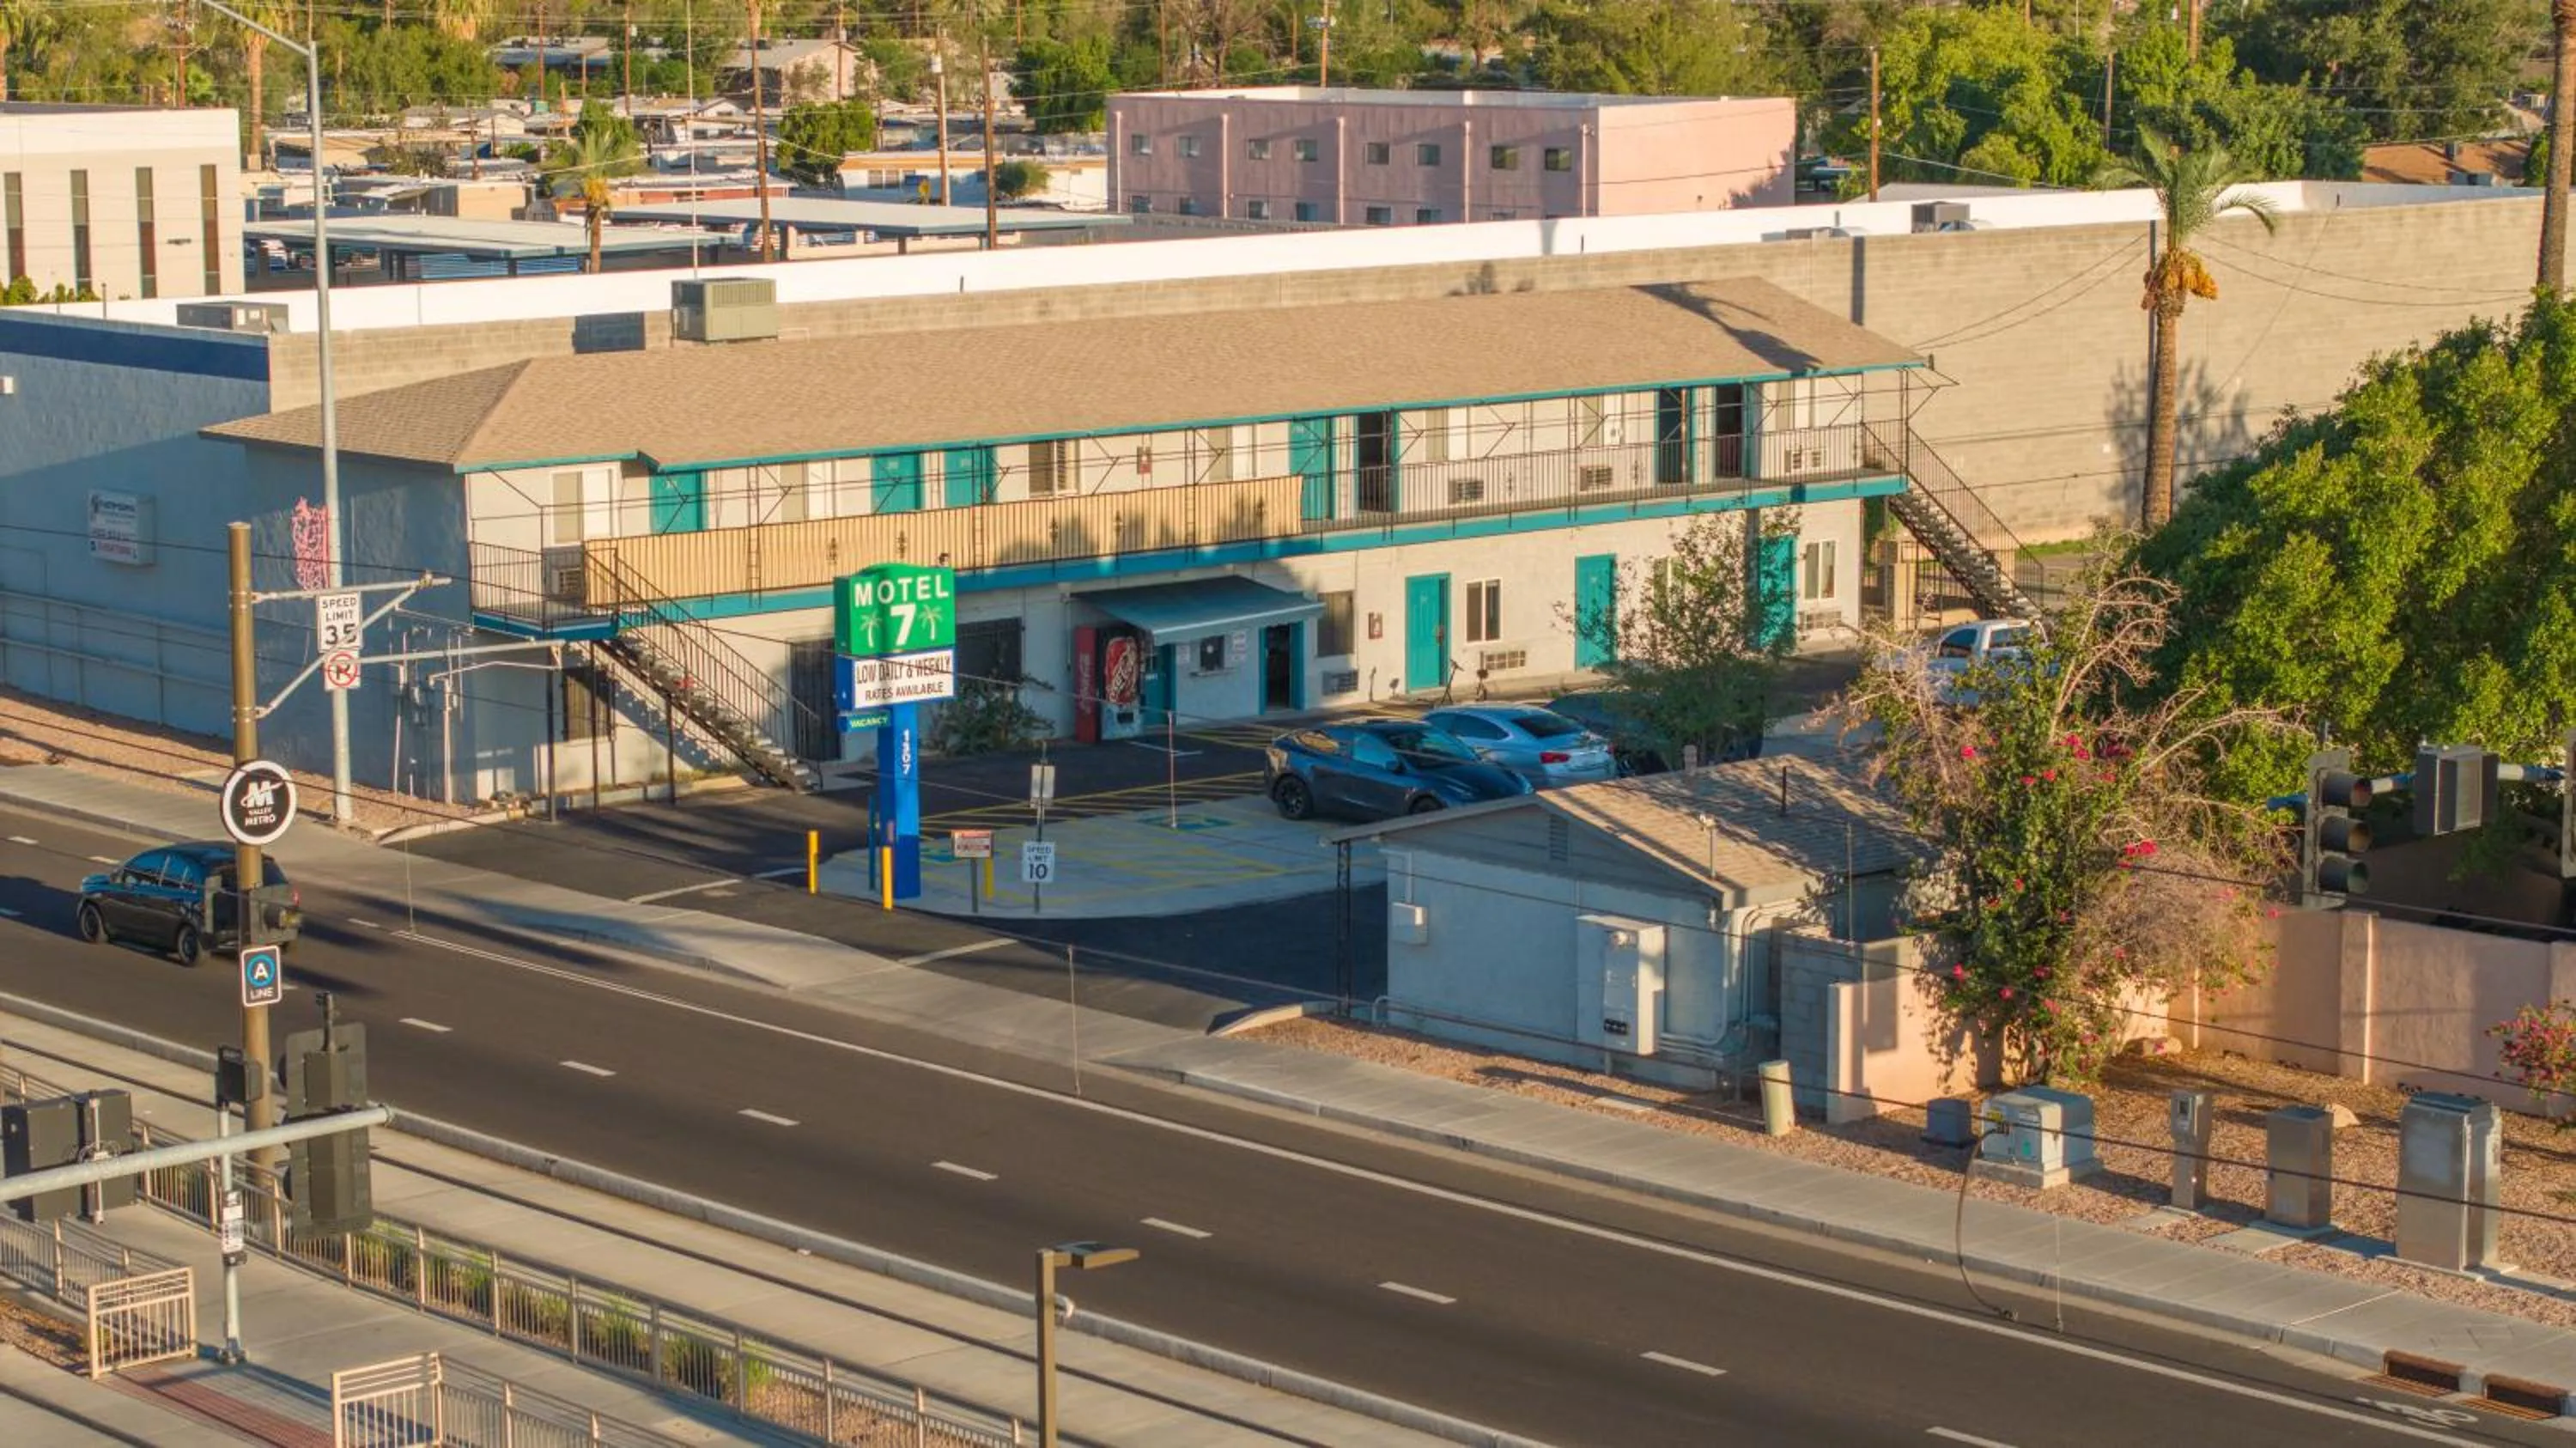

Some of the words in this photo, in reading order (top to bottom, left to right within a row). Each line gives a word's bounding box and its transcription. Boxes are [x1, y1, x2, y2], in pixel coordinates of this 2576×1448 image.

[854, 575, 949, 607] MOTEL
[322, 598, 356, 609] SPEED
[326, 611, 353, 621] LIMIT
[890, 603, 916, 646] 7
[325, 624, 356, 644] 35
[857, 664, 876, 684] LOW
[879, 660, 903, 681] DAILY
[916, 655, 951, 677] WEEKLY
[865, 687, 893, 701] RATES
[896, 682, 944, 697] AVAILABLE
[851, 716, 888, 728] VACANCY
[245, 813, 276, 826] METRO
[1030, 863, 1048, 879] 10
[253, 962, 269, 979] A
[249, 988, 275, 1000] LINE
